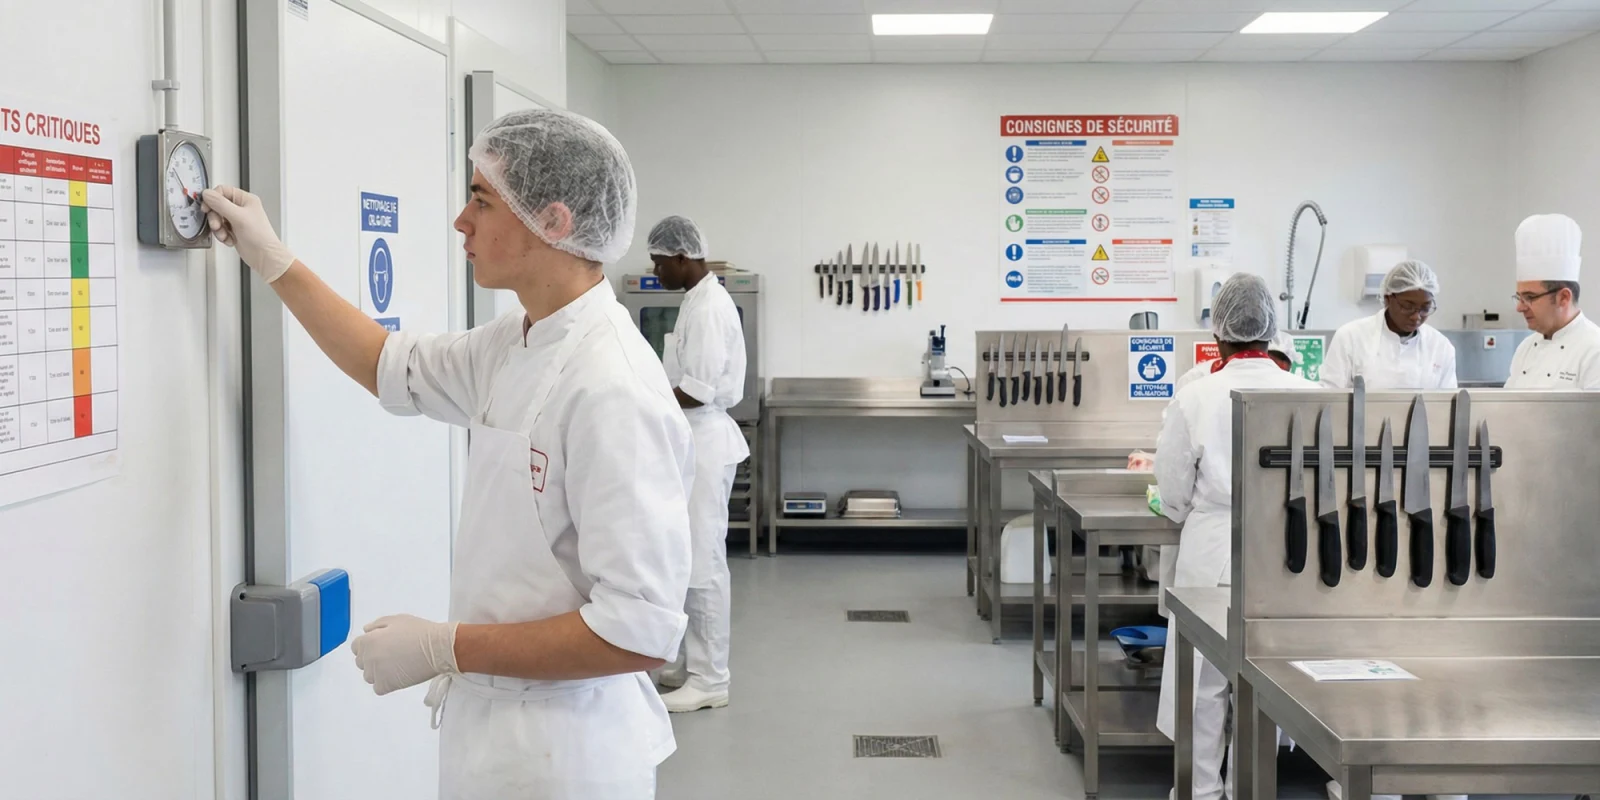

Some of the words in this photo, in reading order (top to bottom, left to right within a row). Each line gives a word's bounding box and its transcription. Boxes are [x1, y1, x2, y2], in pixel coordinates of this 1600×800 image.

[25, 112, 100, 145] CRITIQUES
[1006, 119, 1082, 134] CONSIGNES
[1086, 119, 1104, 133] DE
[1107, 116, 1173, 134] SÉCURITÉ
